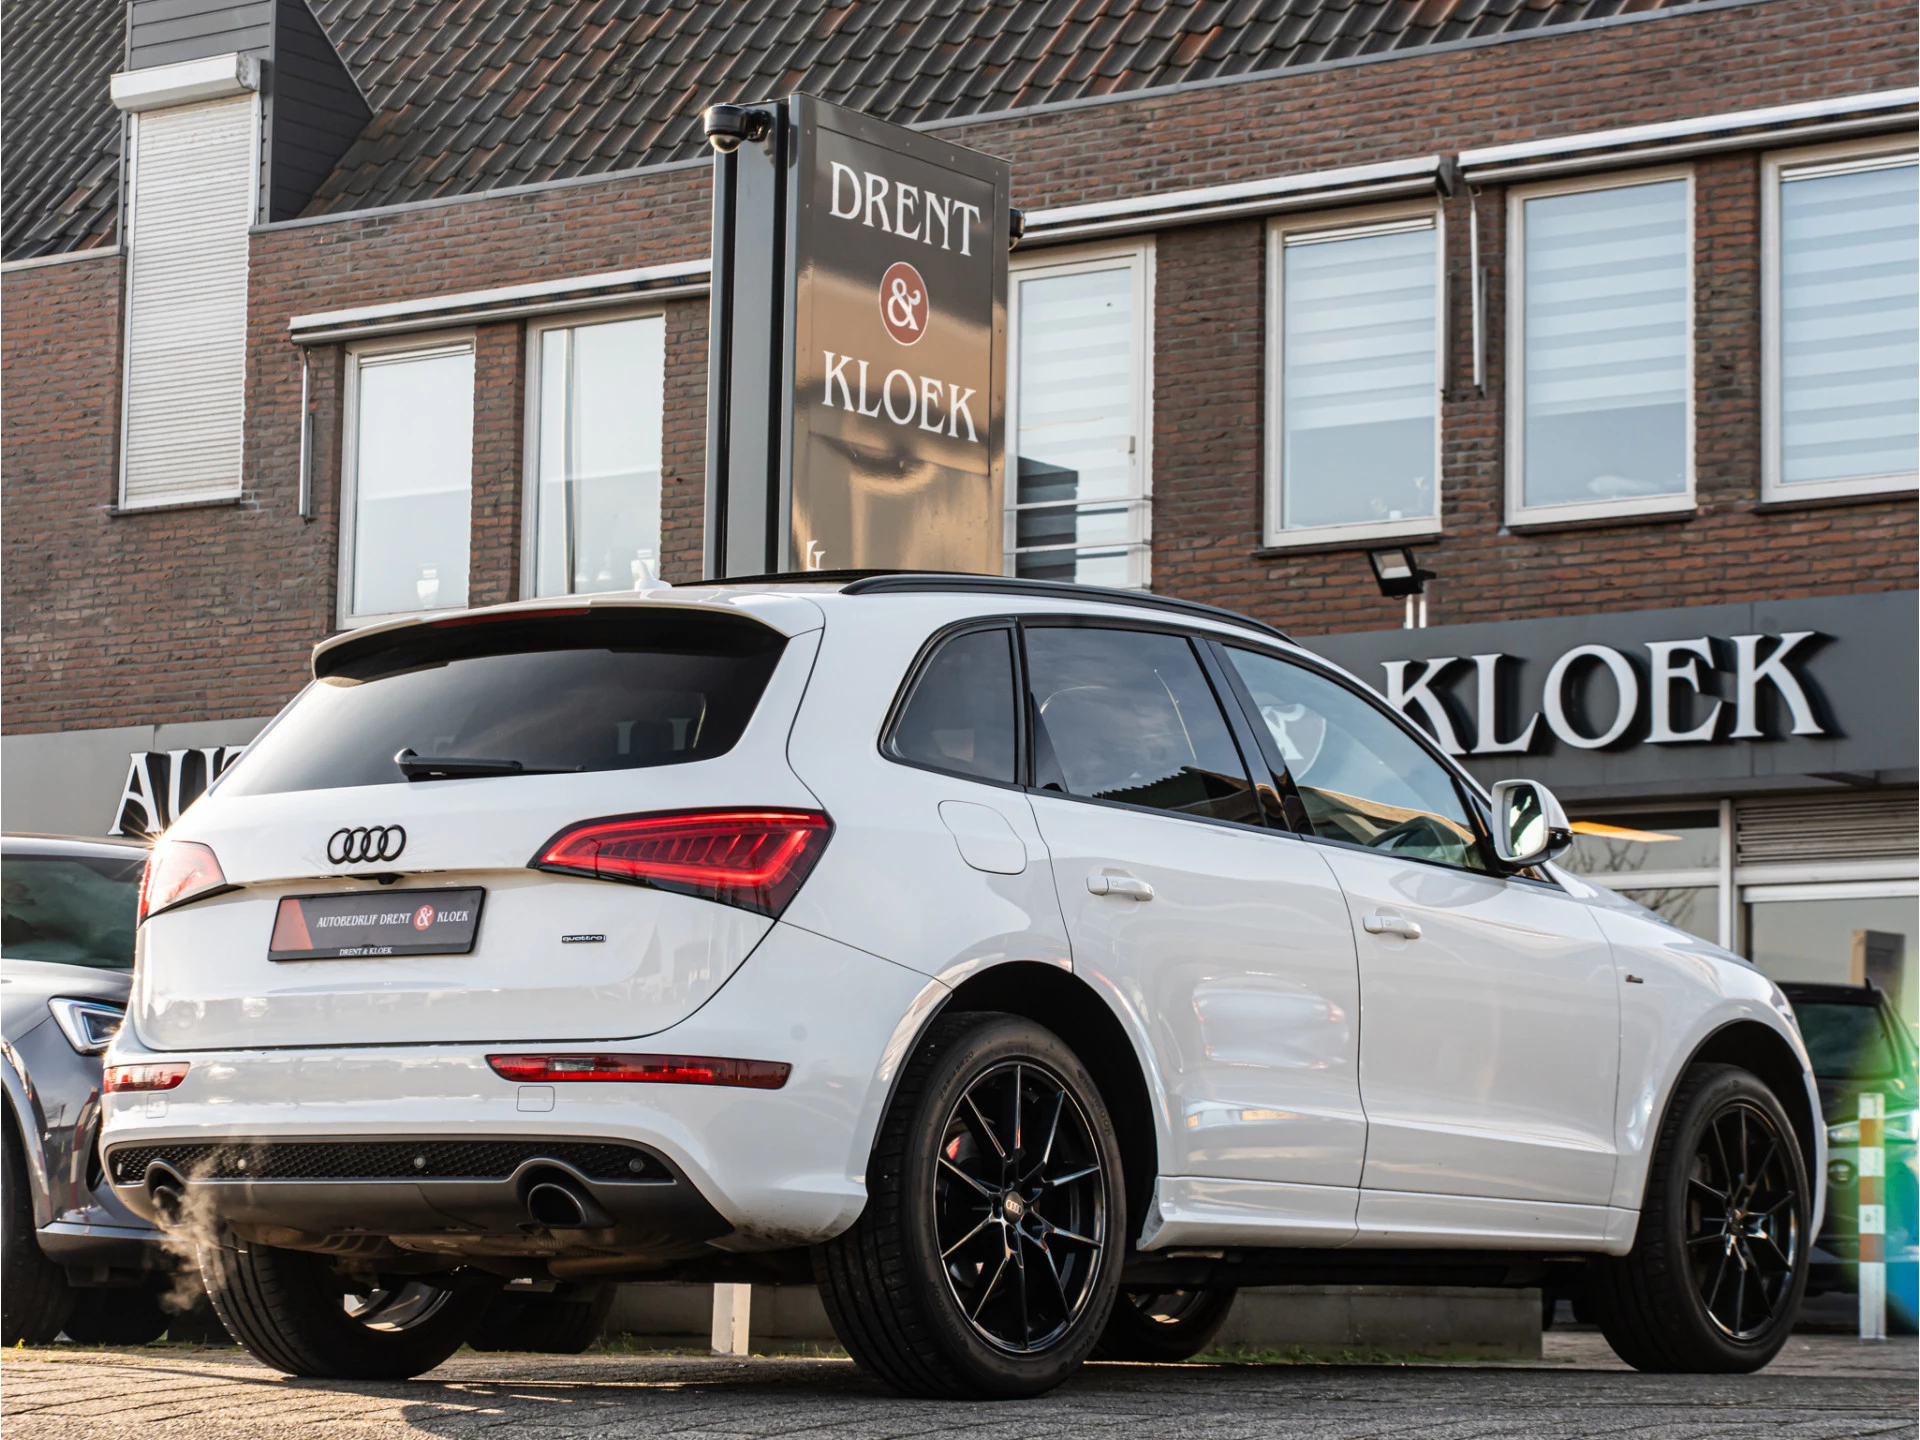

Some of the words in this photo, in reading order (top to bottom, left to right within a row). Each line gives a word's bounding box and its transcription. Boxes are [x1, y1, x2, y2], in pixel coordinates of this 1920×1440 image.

[829, 160, 981, 257] DRENT
[887, 277, 921, 331] &
[822, 350, 979, 443] KLOEK
[1380, 630, 1826, 756] KLOEK
[316, 914, 379, 928] AUTOBEDRIJF
[379, 912, 412, 925] DRENT
[416, 907, 433, 927] &
[436, 910, 469, 923] KLOEK
[562, 935, 603, 943] quattro
[339, 947, 363, 956] DRENT
[369, 946, 393, 955] KLOEK
